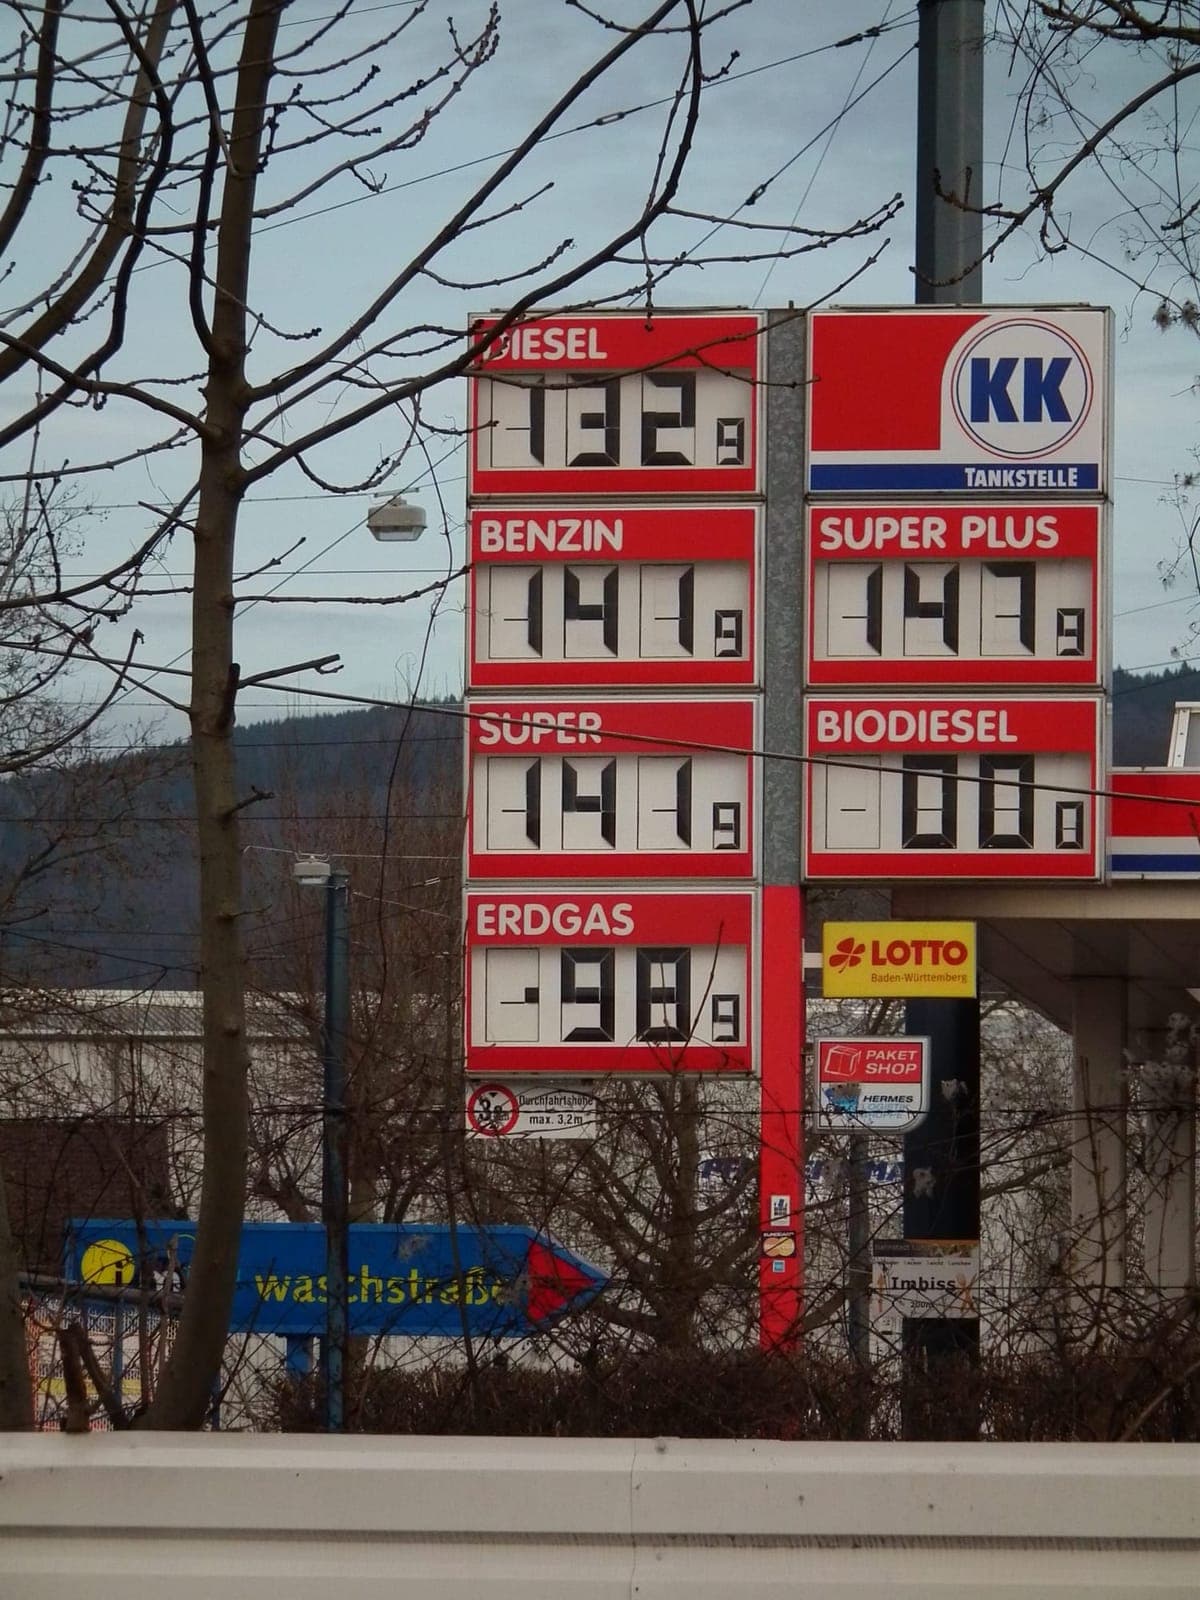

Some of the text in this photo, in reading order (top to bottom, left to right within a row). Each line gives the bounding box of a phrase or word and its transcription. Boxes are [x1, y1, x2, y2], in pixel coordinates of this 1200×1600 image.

[482, 327, 608, 361] DIESEL
[970, 357, 1072, 423] KK
[964, 467, 1078, 488] TANKSTELLE
[479, 519, 623, 553] BENZIN
[819, 515, 1060, 551] SUPER PLUS
[478, 711, 603, 746] SUPER
[816, 709, 1018, 743] BIODIESEL
[476, 903, 635, 936] ERDGAS
[871, 940, 968, 966] LOTTO
[871, 972, 968, 984] Baden-Württemberg
[866, 1050, 918, 1061] PAKET
[865, 1063, 917, 1075] SHOP
[863, 1095, 914, 1103] HERMES
[529, 1114, 583, 1126] max. 3,2m
[891, 1276, 956, 1292] Imbiss
